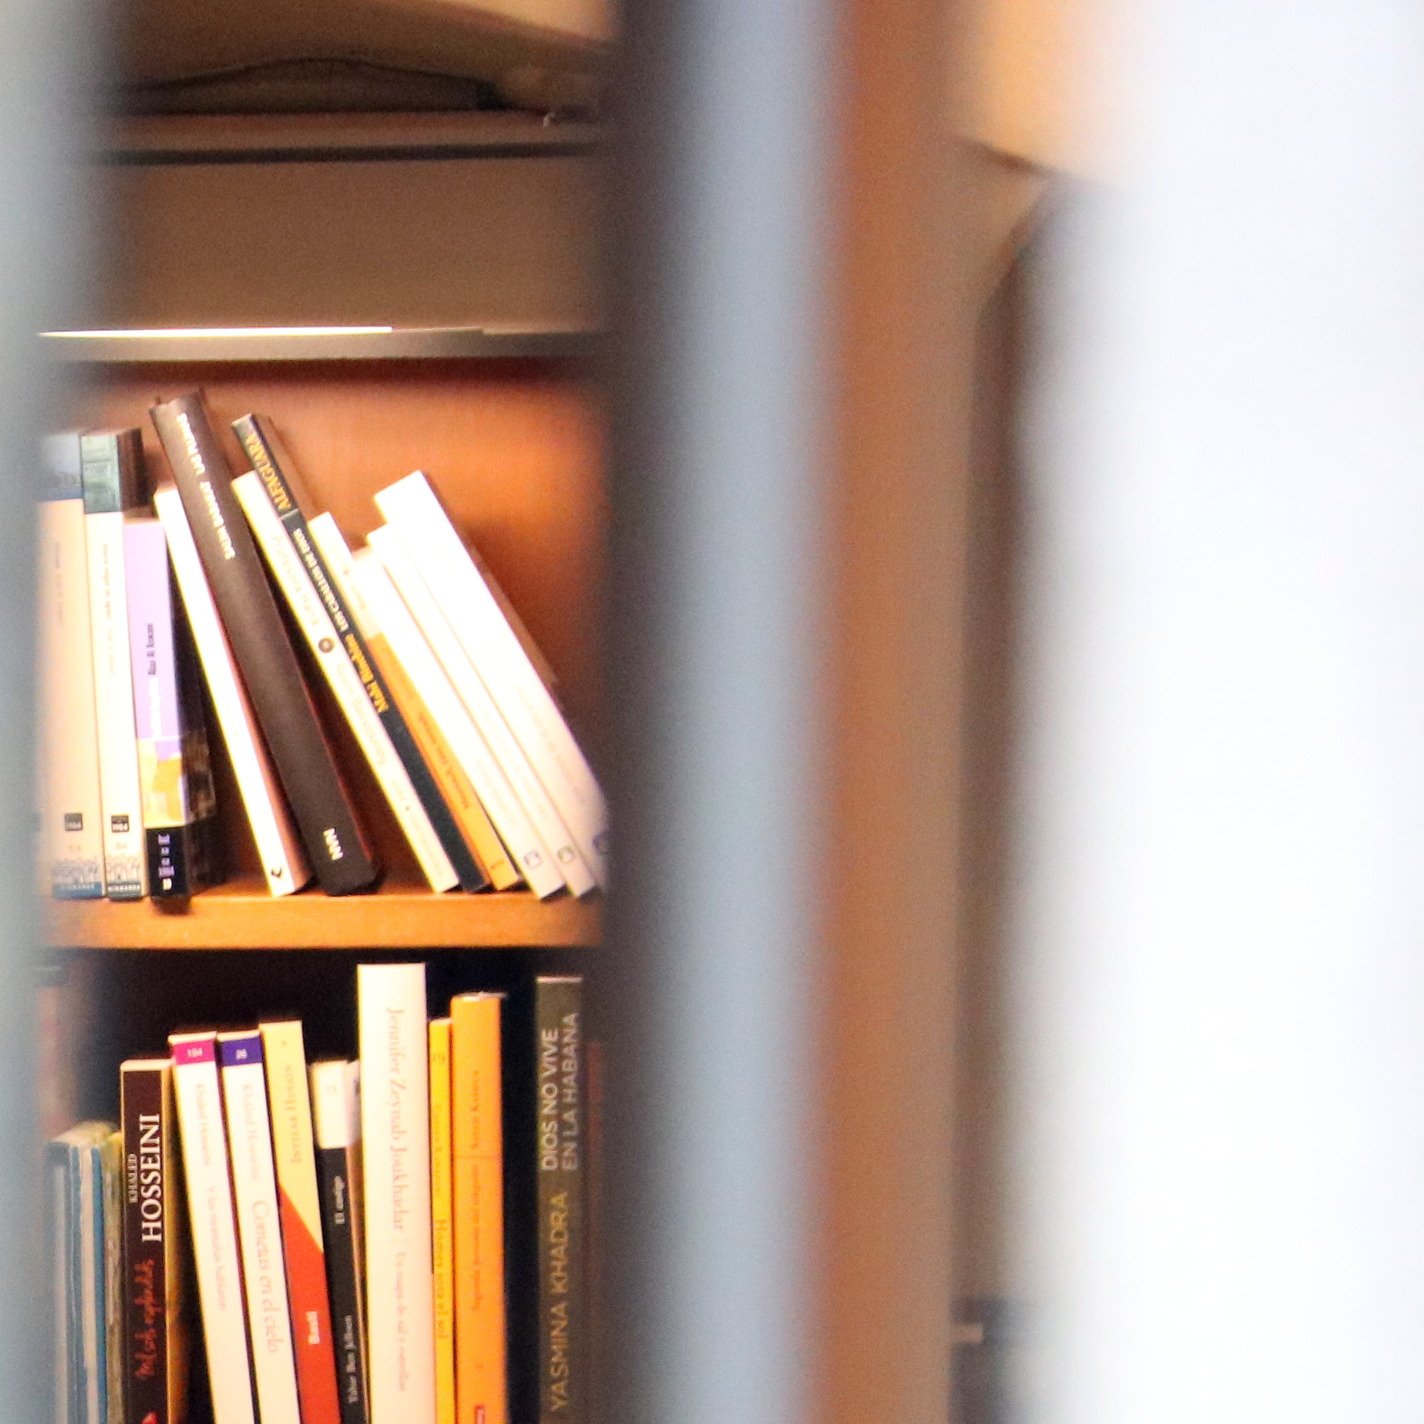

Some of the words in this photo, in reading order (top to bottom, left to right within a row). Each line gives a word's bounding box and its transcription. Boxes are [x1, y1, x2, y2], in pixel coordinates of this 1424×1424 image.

[240, 431, 296, 513] ALFAGUARA
[303, 550, 318, 567] DE
[310, 564, 341, 613] CABALLOS
[332, 610, 350, 632] LOS
[342, 632, 375, 683] Binebine
[365, 680, 390, 713] Mahi
[387, 1006, 407, 1076] Jennifer
[540, 1028, 559, 1079] VIVE
[562, 1012, 579, 1106] HABANA
[387, 1078, 410, 1141] Zeynab
[541, 1083, 559, 1115] NO
[562, 1110, 579, 1138] LA
[541, 1121, 559, 1171] DIOS
[562, 1141, 579, 1171] EN
[128, 1153, 139, 1204] KHALED
[140, 1113, 163, 1243] HOSSEINI
[390, 1143, 410, 1231] Joukhadar
[250, 1200, 274, 1271] Cometas
[434, 1218, 450, 1272] Homes
[549, 1193, 569, 1295] KHADRA
[261, 1278, 274, 1296] en
[263, 1299, 280, 1315] el
[264, 1317, 283, 1354] cielo
[437, 1320, 451, 1341] sol
[550, 1303, 570, 1413] YASMINA
